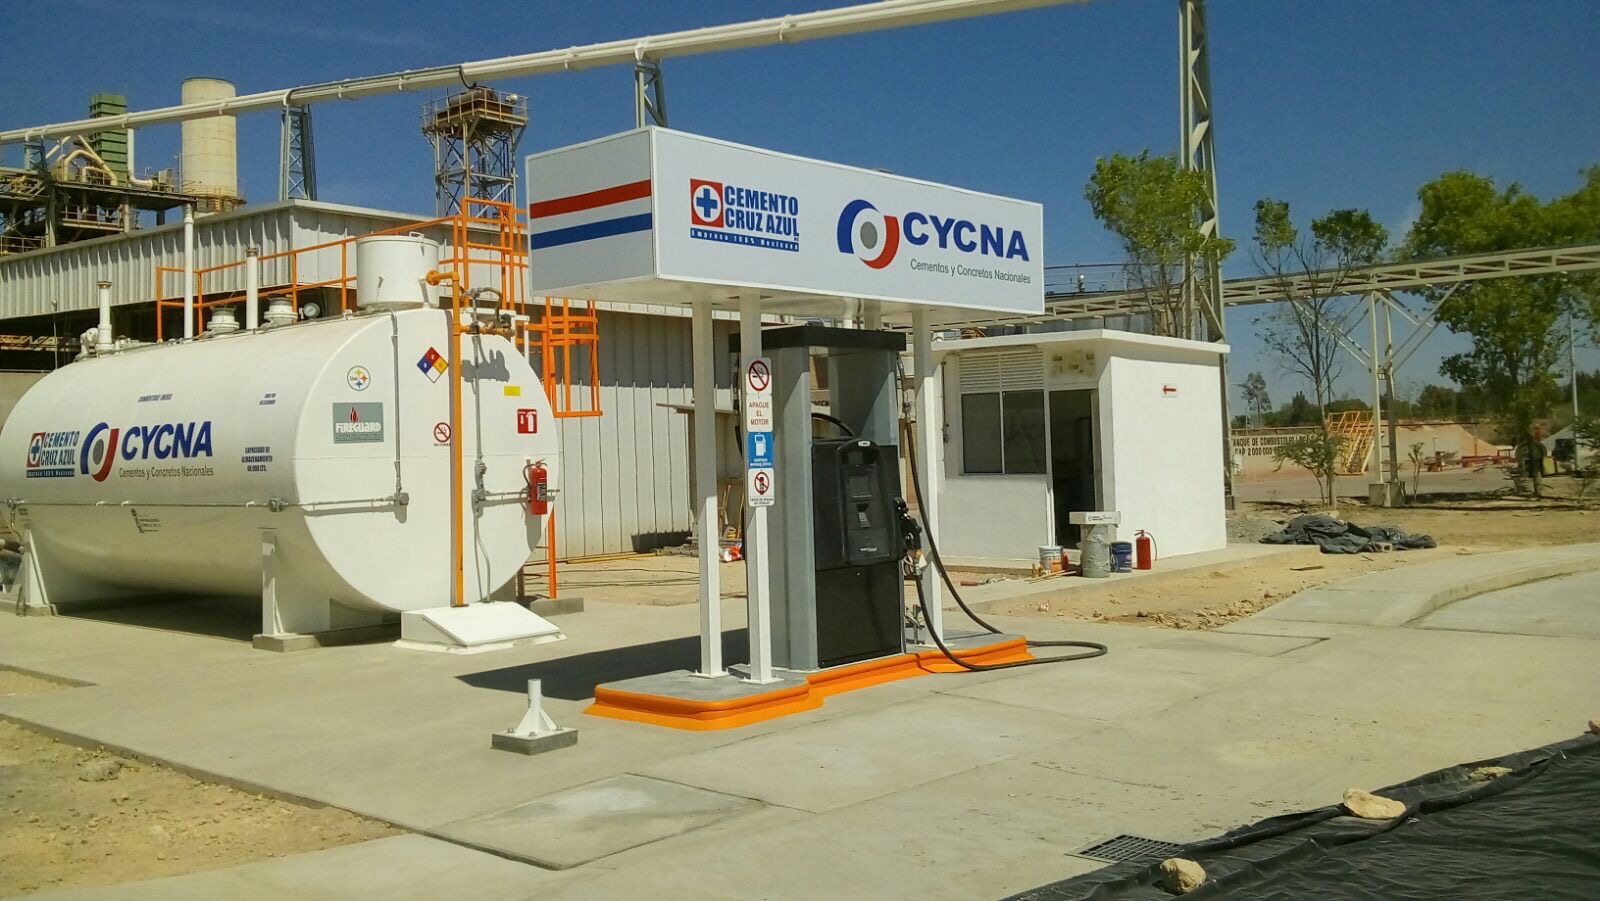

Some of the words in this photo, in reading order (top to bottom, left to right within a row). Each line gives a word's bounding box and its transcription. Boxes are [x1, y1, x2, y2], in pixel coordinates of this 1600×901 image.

[724, 185, 799, 216] CEMENTO
[724, 207, 763, 232] CRUZ
[766, 213, 800, 237] AZUL
[733, 235, 755, 245] 100%
[902, 211, 1030, 262] CYCNA
[910, 258, 949, 274] Cementos
[950, 266, 956, 276] y
[957, 264, 993, 280] Concretos
[994, 269, 1031, 284] Nacionales
[748, 401, 769, 409] APAGUE
[750, 418, 769, 426] MOTOR
[44, 430, 80, 448] CEMENTO
[121, 420, 213, 461] CYCNA
[1232, 437, 1250, 447] ANQUE
[1252, 437, 1259, 446] DE
[41, 449, 59, 466] CRUZ
[58, 449, 75, 466] AZUL
[119, 467, 145, 478] Cementos
[150, 467, 180, 478] Concretos
[181, 466, 214, 477] Nacionales
